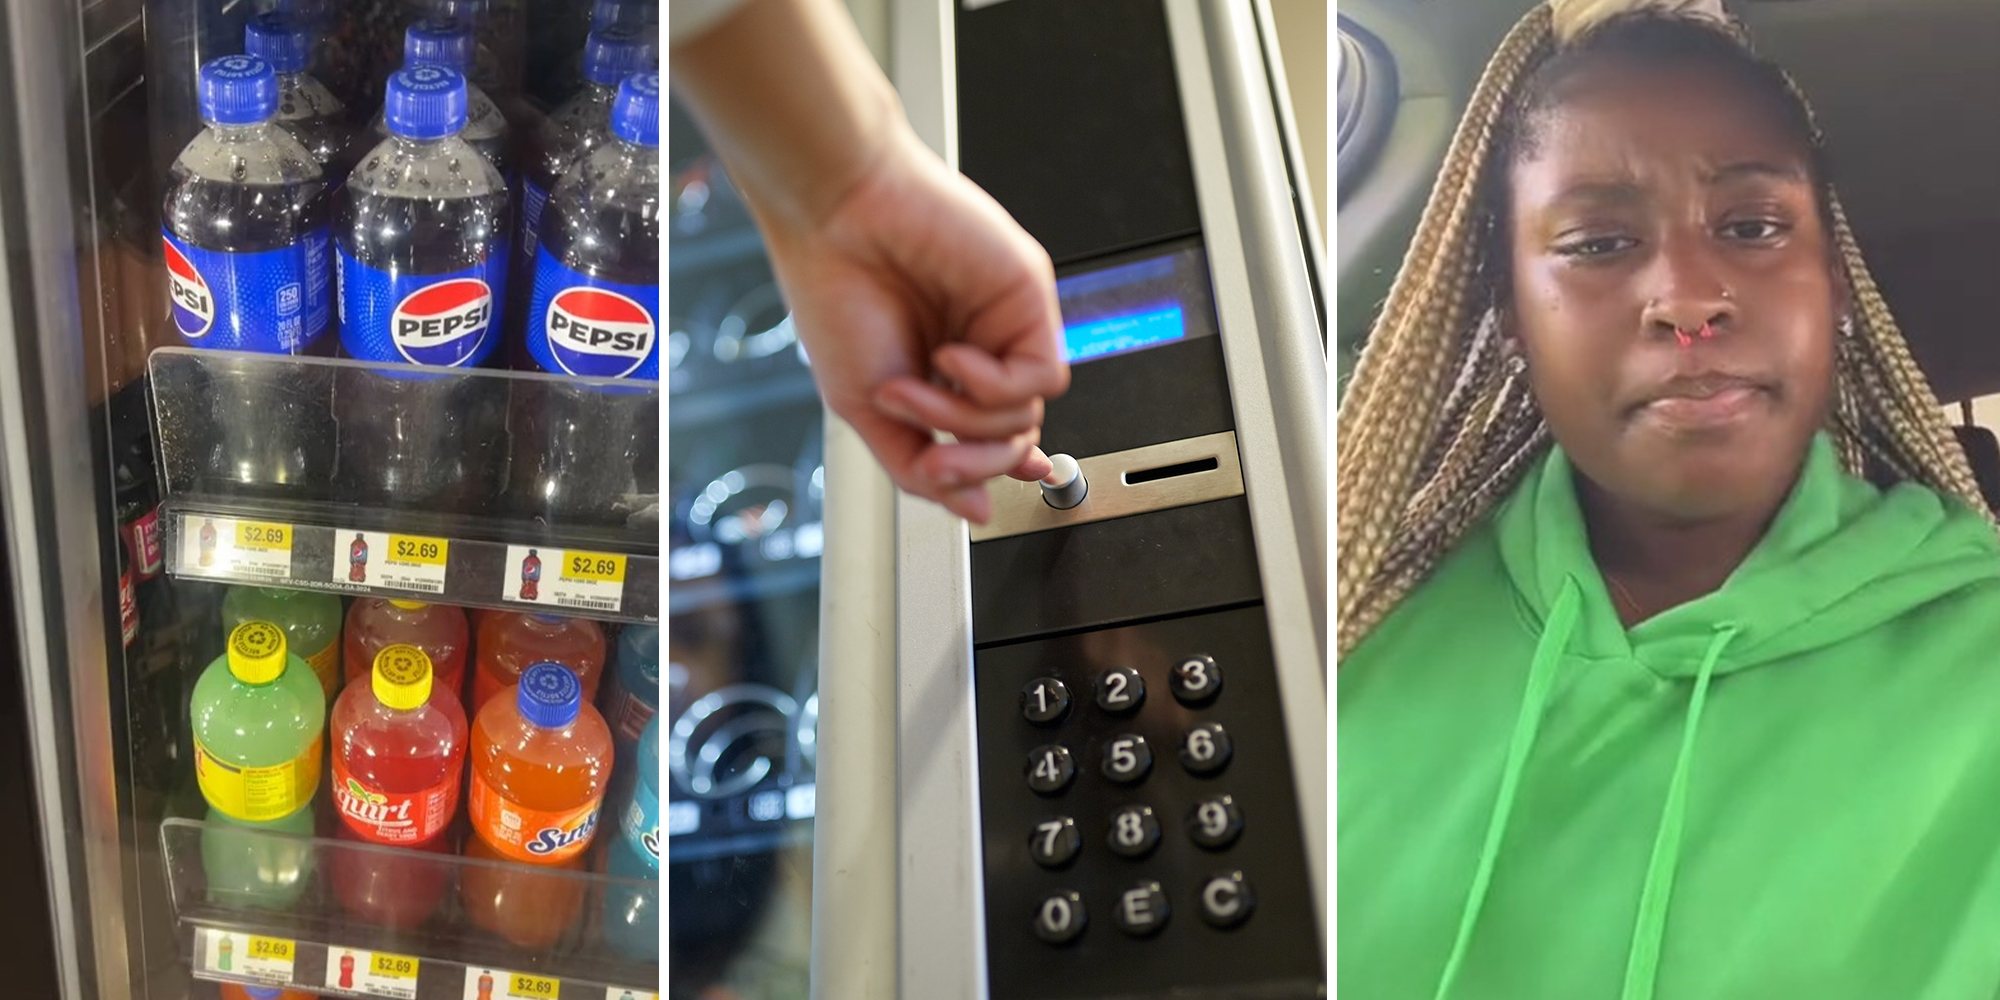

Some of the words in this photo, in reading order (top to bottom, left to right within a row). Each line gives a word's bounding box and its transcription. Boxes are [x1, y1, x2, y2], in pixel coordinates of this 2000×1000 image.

[169, 277, 208, 314] PSI
[280, 287, 298, 302] 250
[398, 302, 489, 338] PEPSI
[551, 310, 648, 352] PEPSI
[244, 526, 284, 543] $2.69
[397, 540, 438, 559] $2.69
[572, 557, 616, 576] $2.69
[1033, 683, 1047, 713] 1
[1105, 672, 1130, 703] 2
[1182, 660, 1208, 690] 3
[1035, 751, 1060, 782] 4
[1112, 740, 1137, 773] 5
[1187, 728, 1215, 761] 6
[1038, 820, 1063, 857] 7
[1116, 811, 1144, 847] 8
[1198, 801, 1228, 837] 9
[1041, 896, 1071, 932] 0
[1122, 887, 1154, 925] E
[1203, 877, 1240, 917] C
[255, 940, 288, 956] $2.69
[378, 958, 411, 974] $2.69
[517, 978, 551, 994] $2.69
